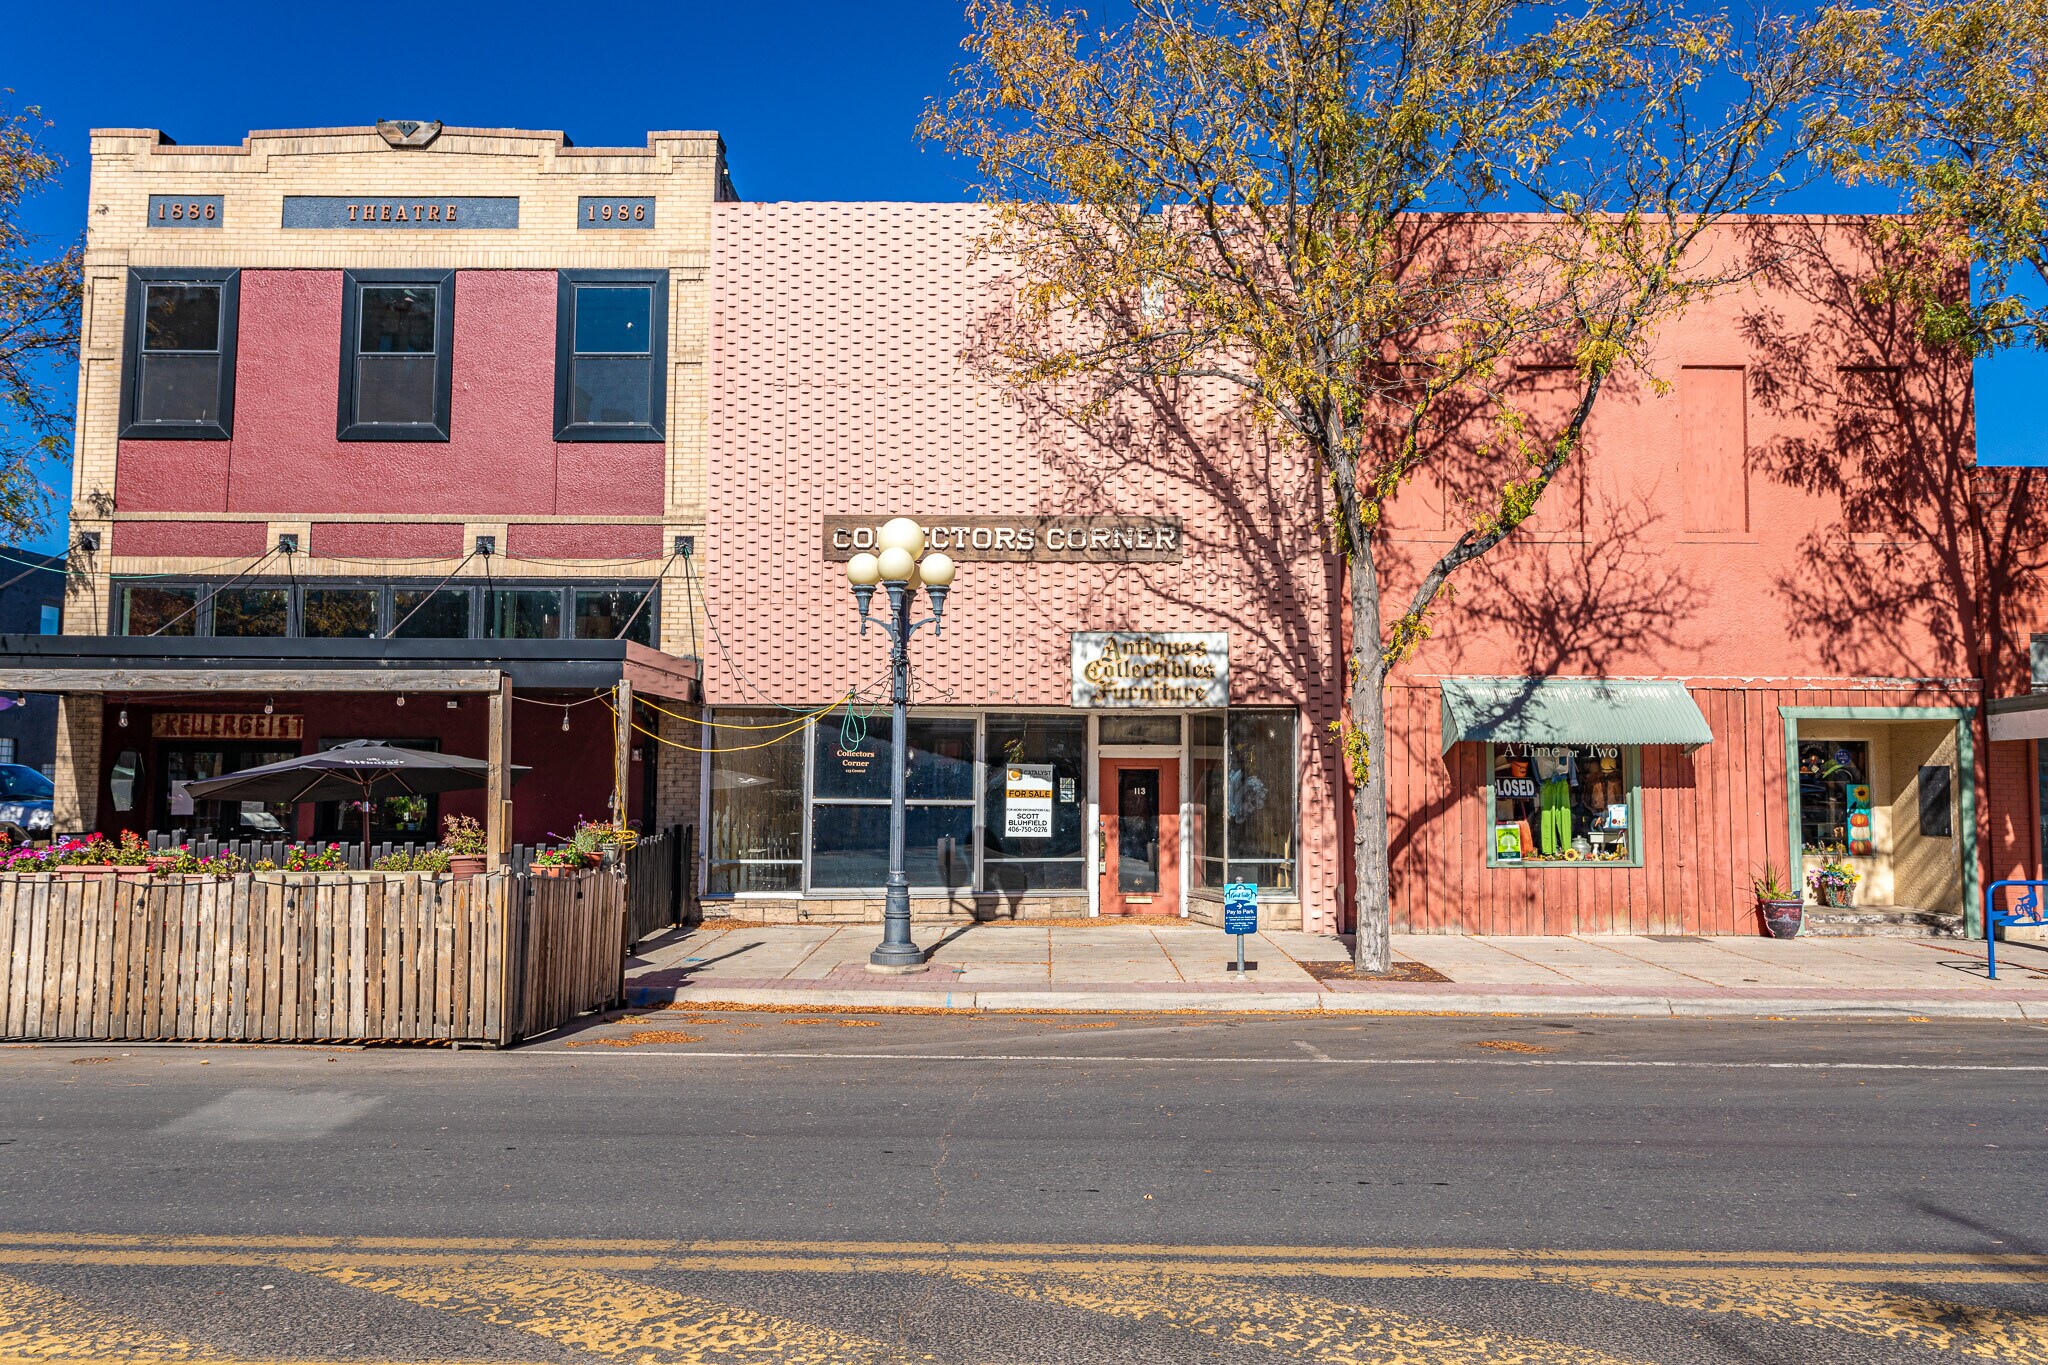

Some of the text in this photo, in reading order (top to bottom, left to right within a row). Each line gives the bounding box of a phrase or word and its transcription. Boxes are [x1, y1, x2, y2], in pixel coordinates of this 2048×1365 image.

[158, 203, 216, 220] 1886
[347, 204, 458, 221] THEATRE
[588, 204, 645, 221] 1986
[1046, 527, 1176, 551] CORNER
[1102, 636, 1208, 661] Antiques
[1084, 656, 1216, 683] Collectibles
[1091, 680, 1209, 702] Furniture
[164, 714, 303, 737] KELLERGEIST
[836, 750, 875, 758] Collectors
[1504, 743, 1618, 759] A Time or Two
[842, 759, 870, 767] Corner
[1134, 787, 1146, 795] 113
